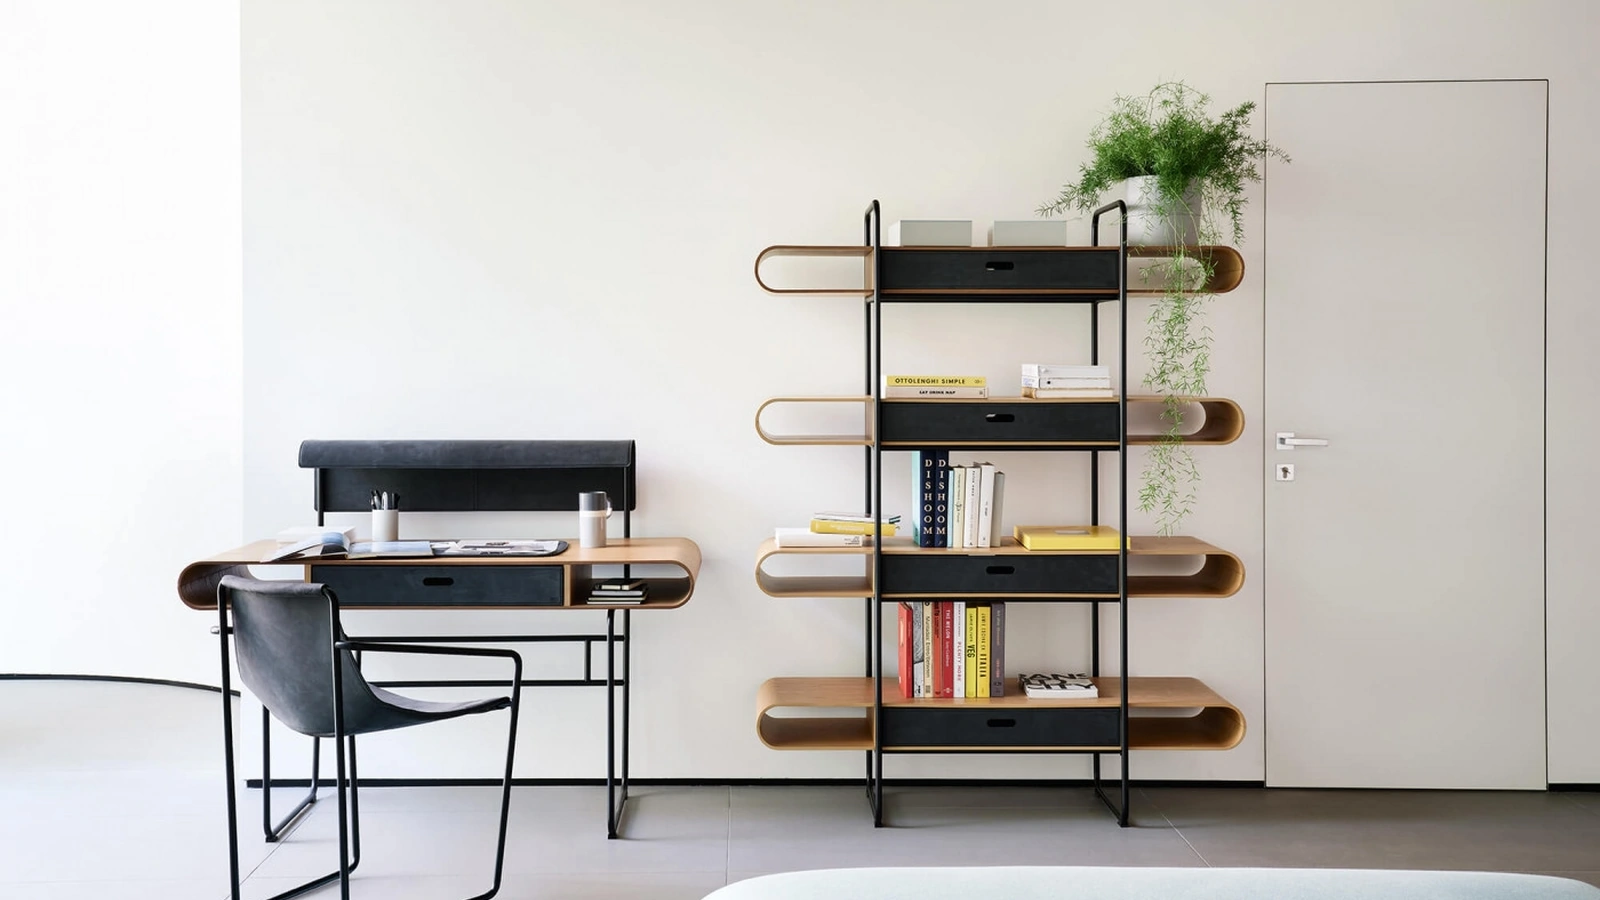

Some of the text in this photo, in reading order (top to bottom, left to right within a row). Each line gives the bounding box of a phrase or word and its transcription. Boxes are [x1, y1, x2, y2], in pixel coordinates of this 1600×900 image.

[941, 377, 966, 385] SIMPLE
[923, 459, 933, 535] DISHOOM
[936, 459, 946, 535] DISHOOM
[966, 644, 976, 658] VEG
[979, 653, 987, 678] ITALIA
